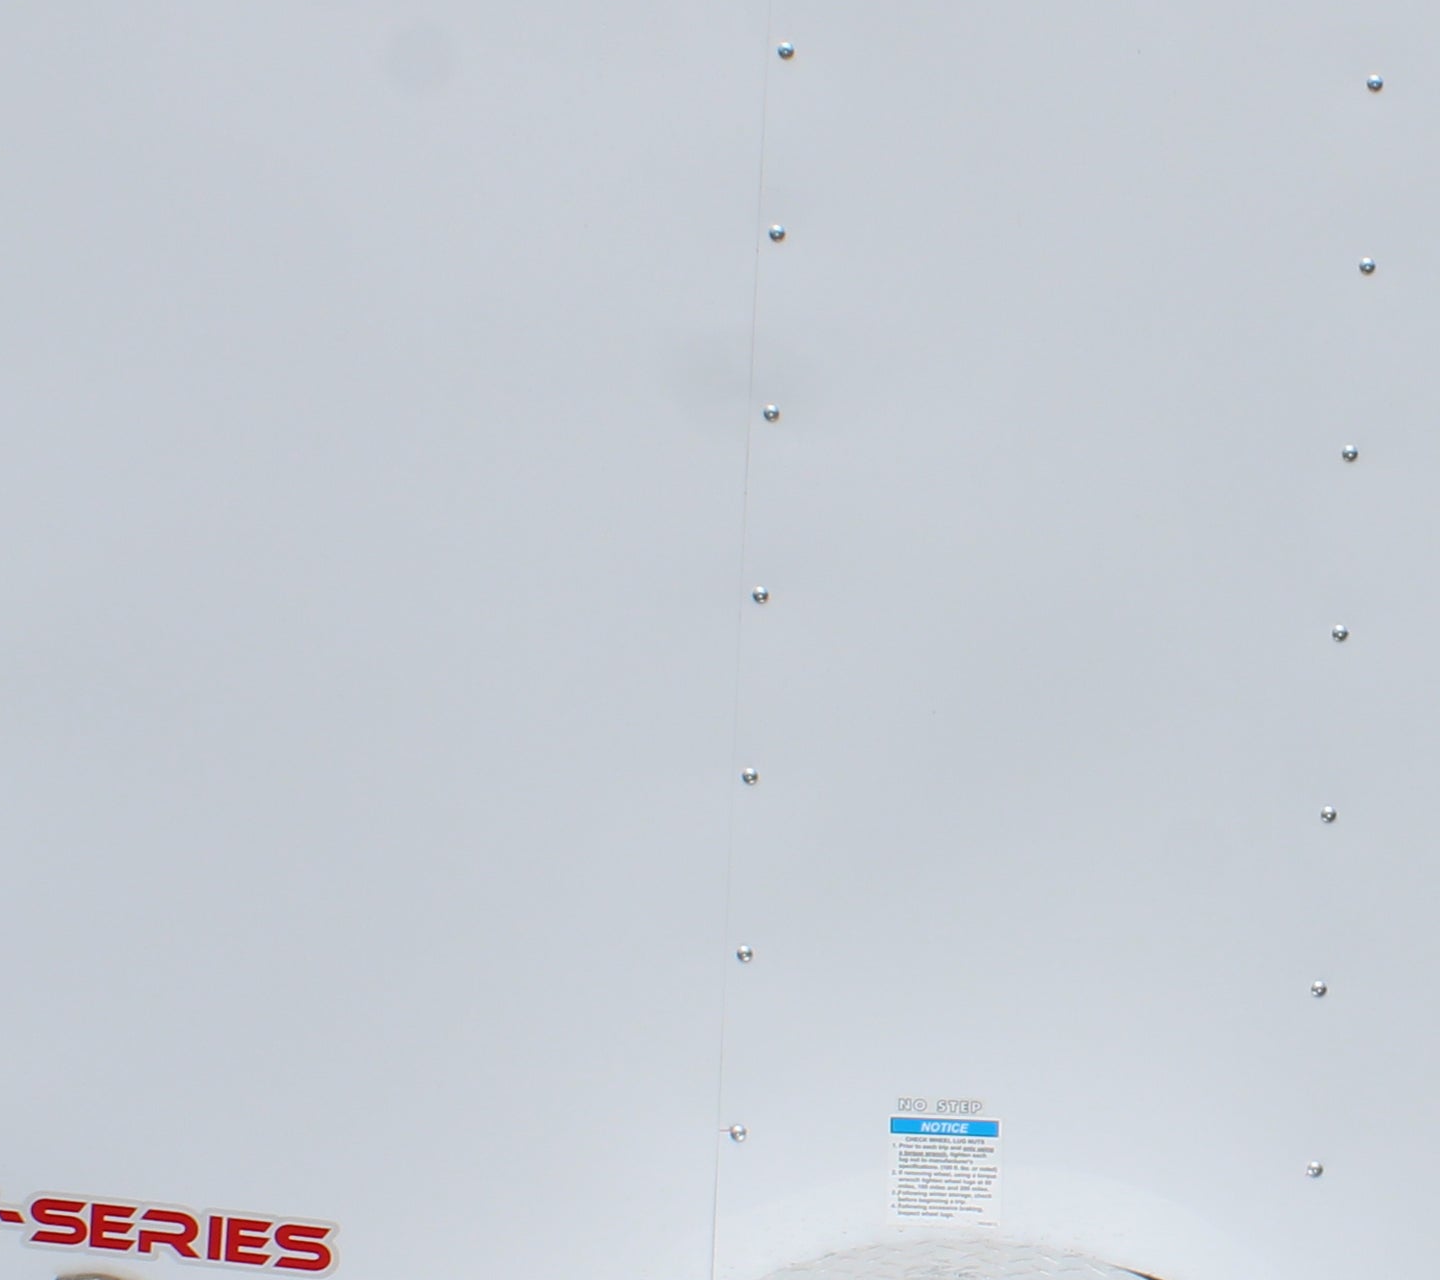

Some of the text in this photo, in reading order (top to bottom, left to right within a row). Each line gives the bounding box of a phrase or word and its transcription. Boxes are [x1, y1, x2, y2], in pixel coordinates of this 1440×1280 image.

[898, 1098, 982, 1113] NO STEP
[921, 1121, 970, 1134] NOTICE
